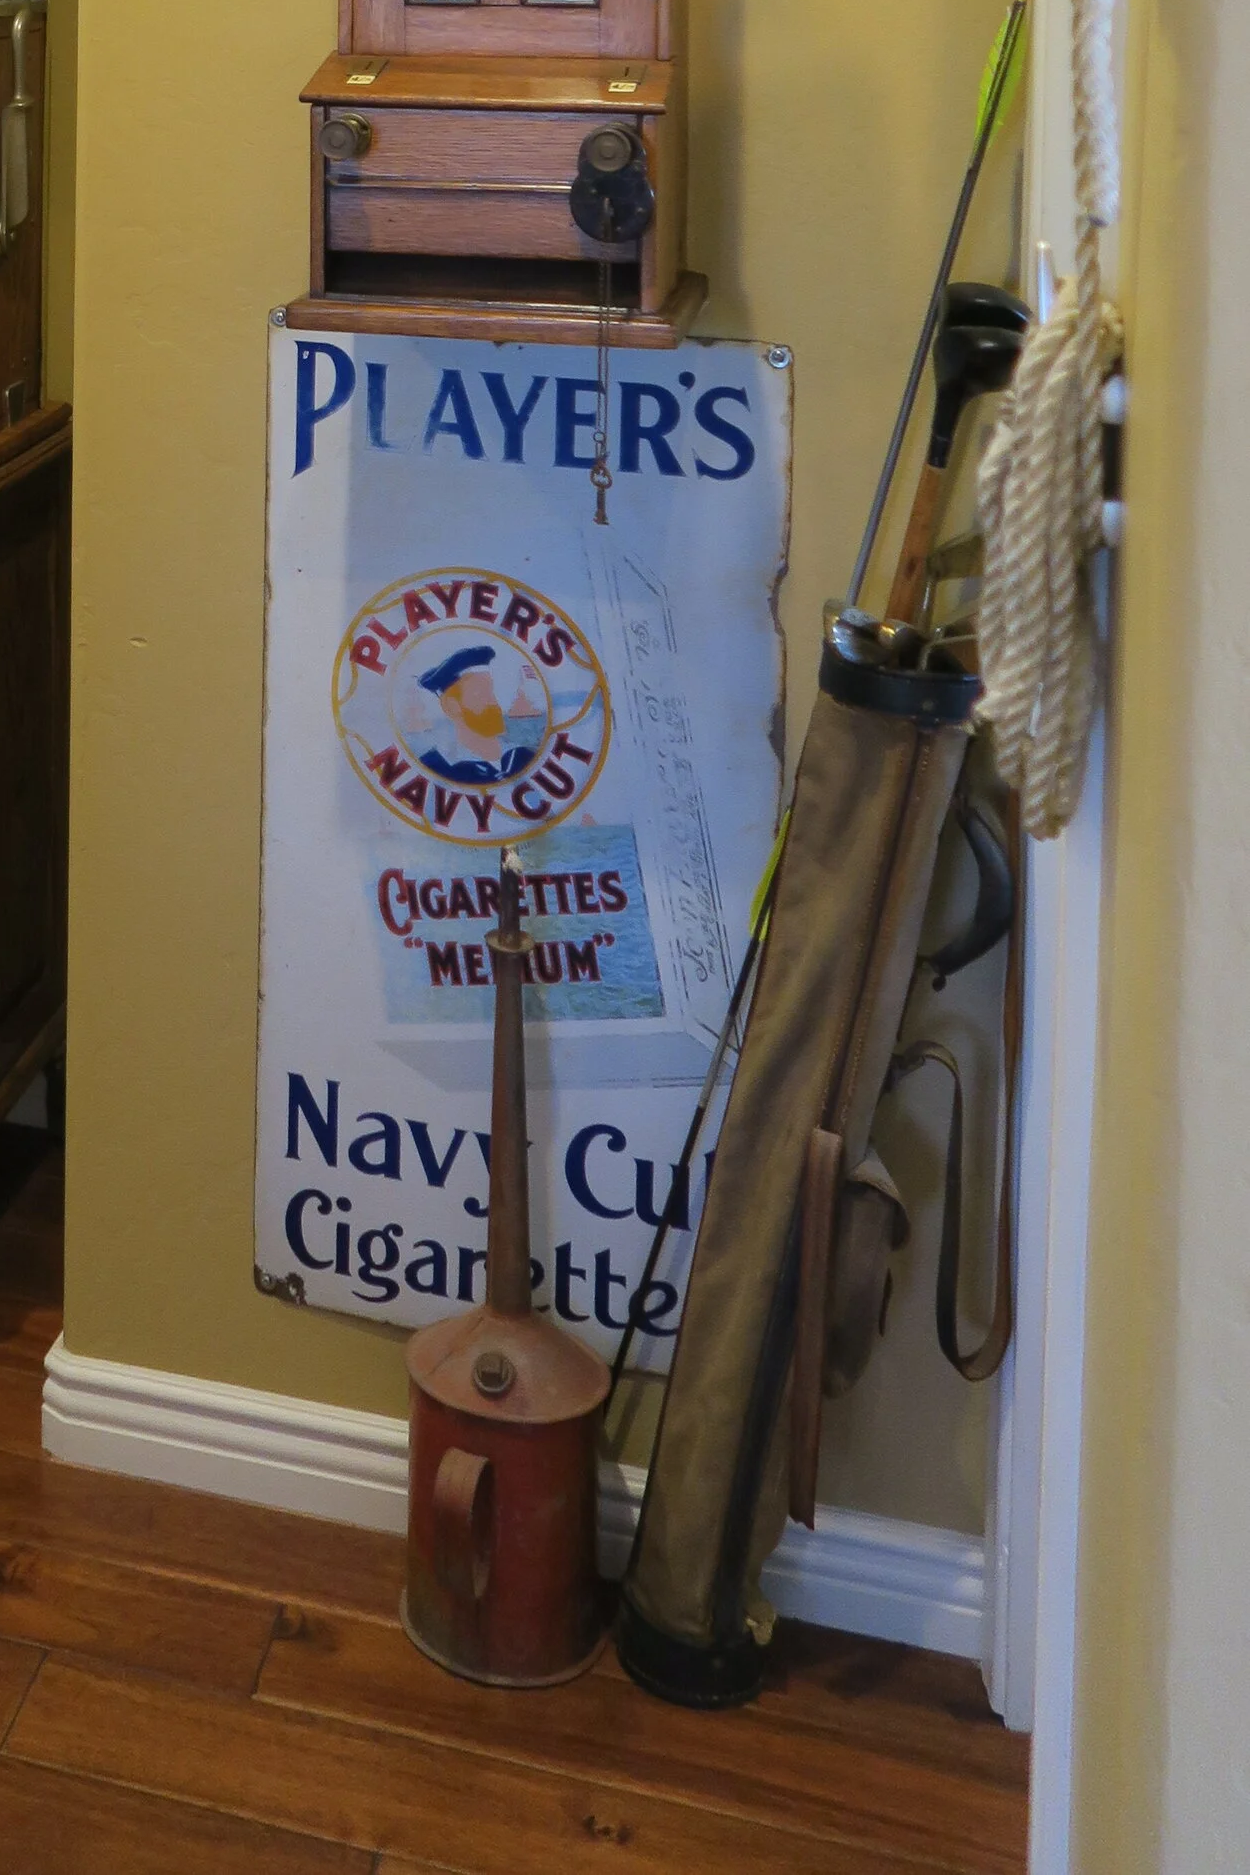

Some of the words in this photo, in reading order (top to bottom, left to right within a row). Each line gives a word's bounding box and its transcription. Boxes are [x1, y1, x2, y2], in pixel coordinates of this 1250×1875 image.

[290, 339, 756, 482] PLAYER'S
[350, 579, 578, 676] PLAYER'S
[364, 743, 497, 834] NAVY
[510, 731, 595, 821] CUT
[404, 932, 616, 987] “MEIUM”
[564, 1123, 715, 1231] Cu
